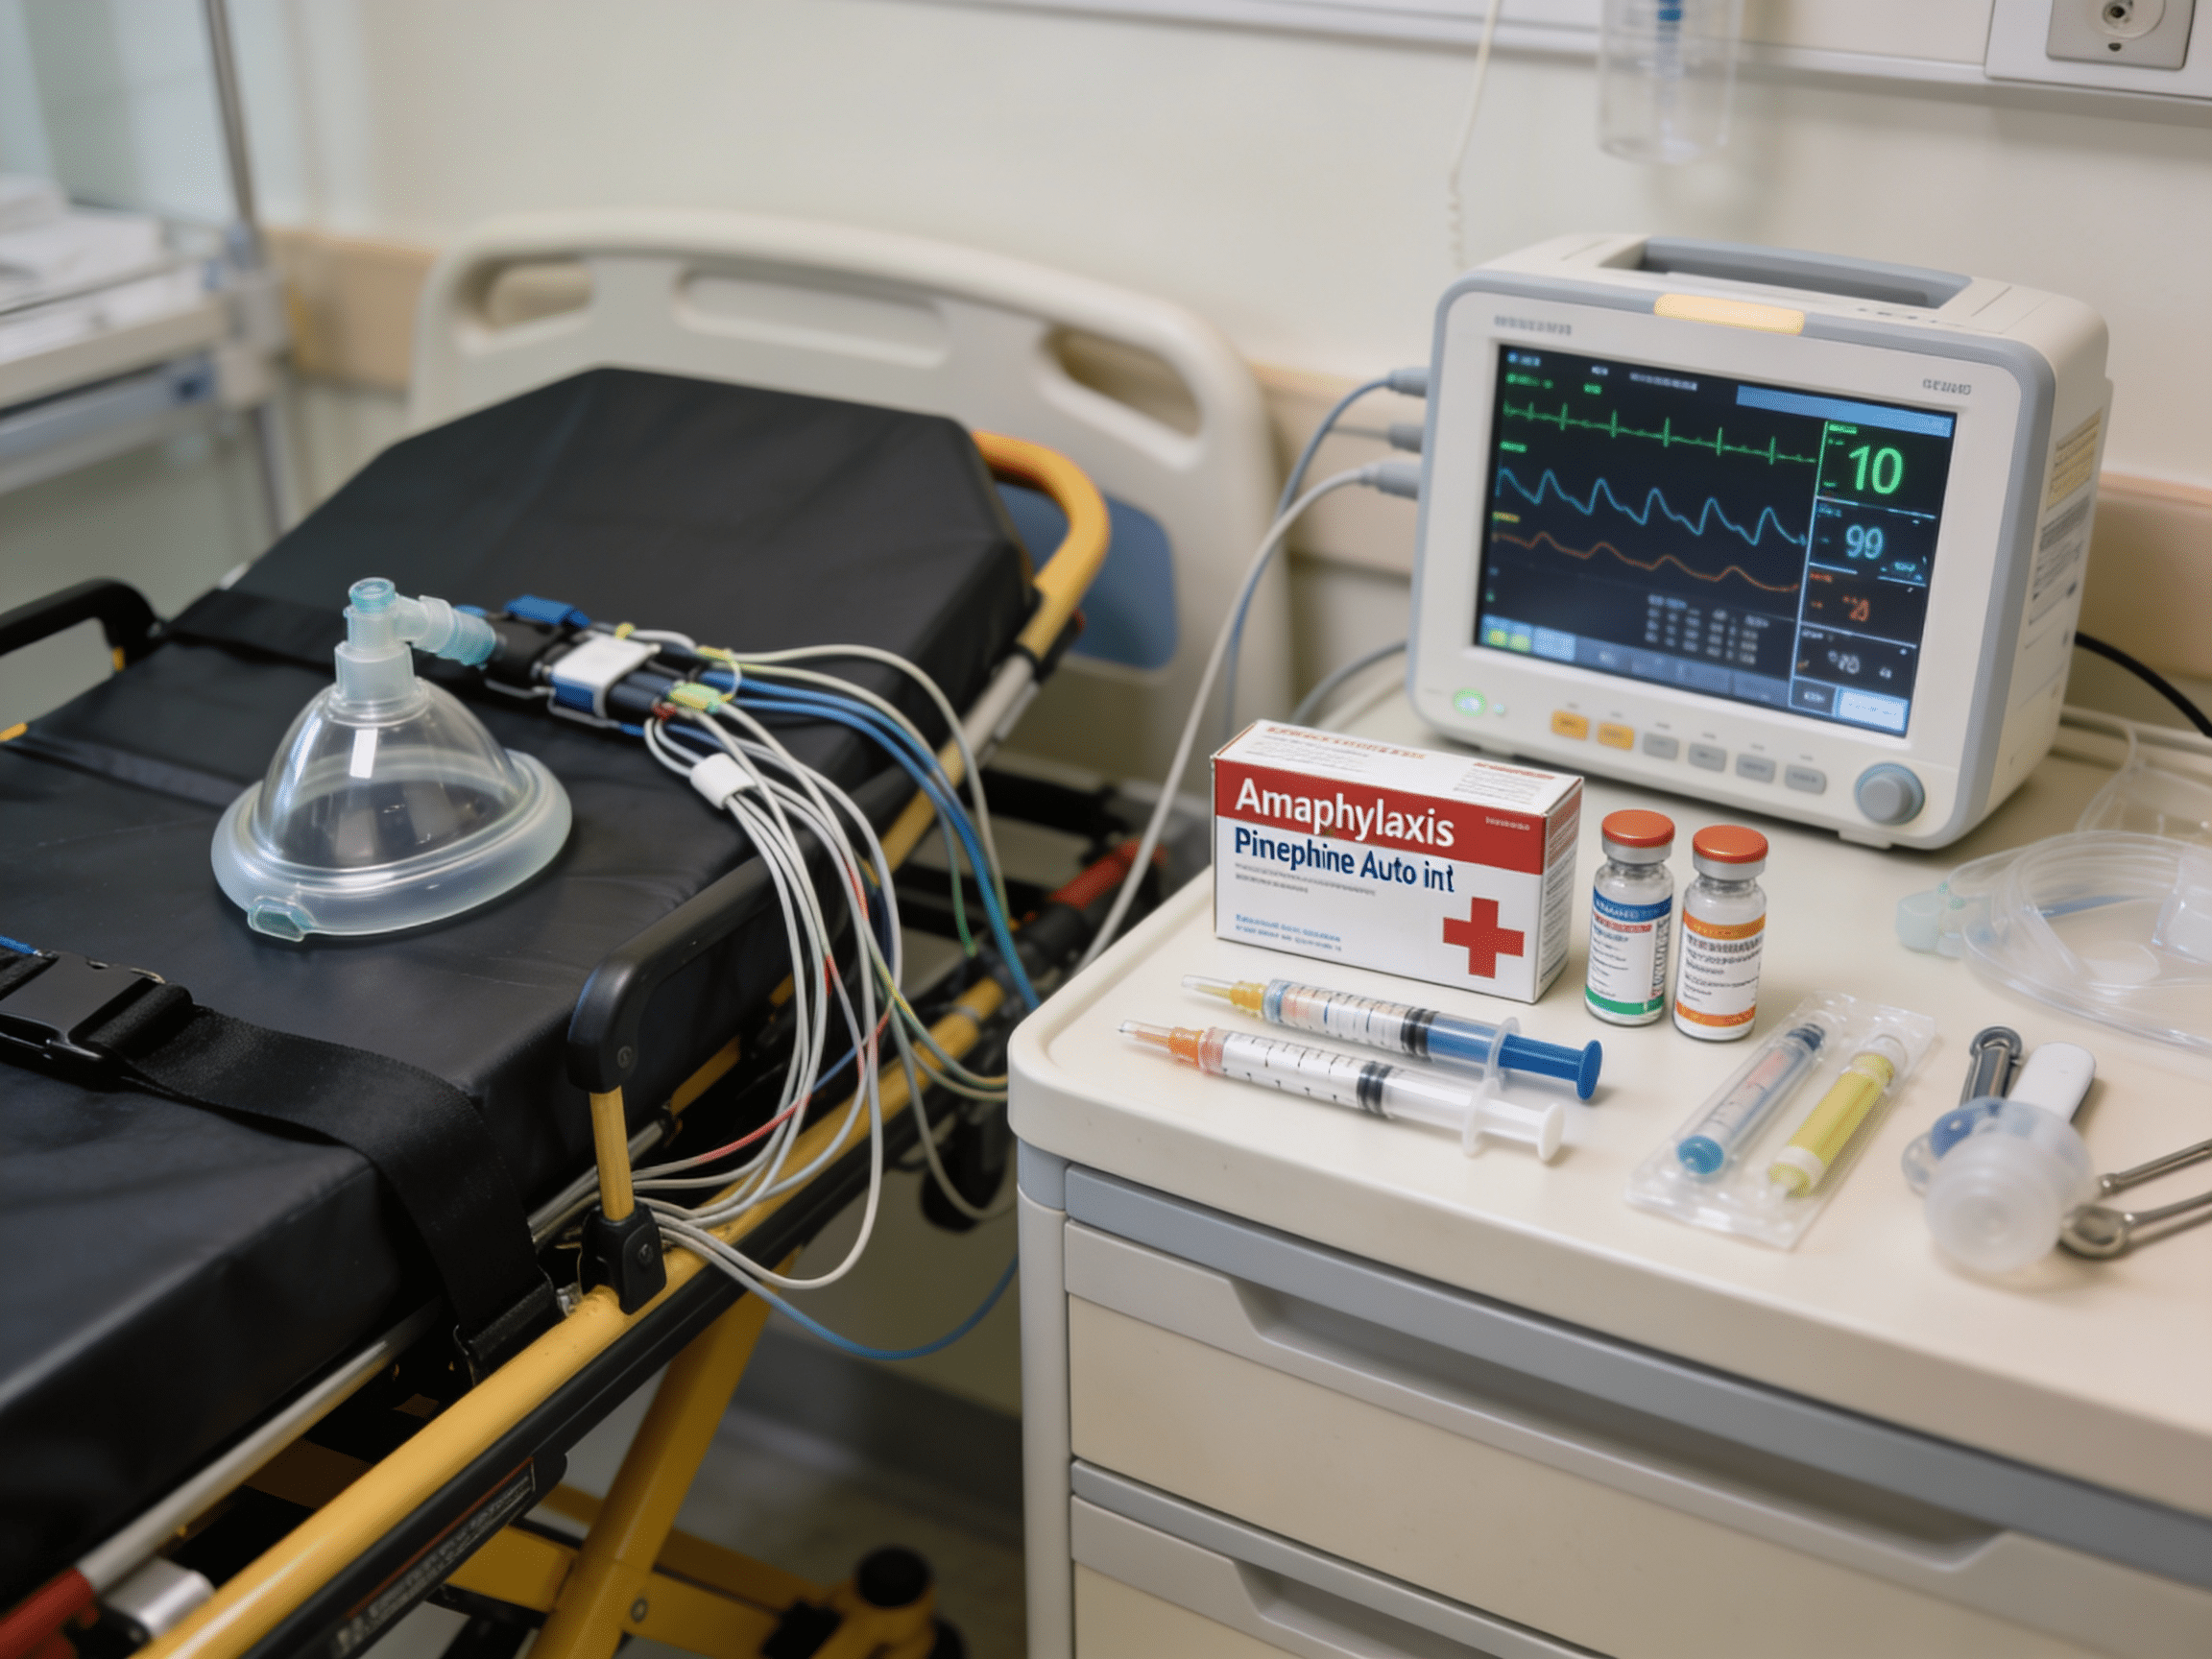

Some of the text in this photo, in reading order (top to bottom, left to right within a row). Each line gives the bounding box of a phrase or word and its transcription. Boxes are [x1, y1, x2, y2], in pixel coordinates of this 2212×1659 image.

[1848, 445, 1903, 494] 10
[1235, 778, 1455, 848] Amaphylaxis
[1235, 827, 1356, 875] Pinephine
[1359, 850, 1417, 885] Auto
[1424, 860, 1455, 893] int
